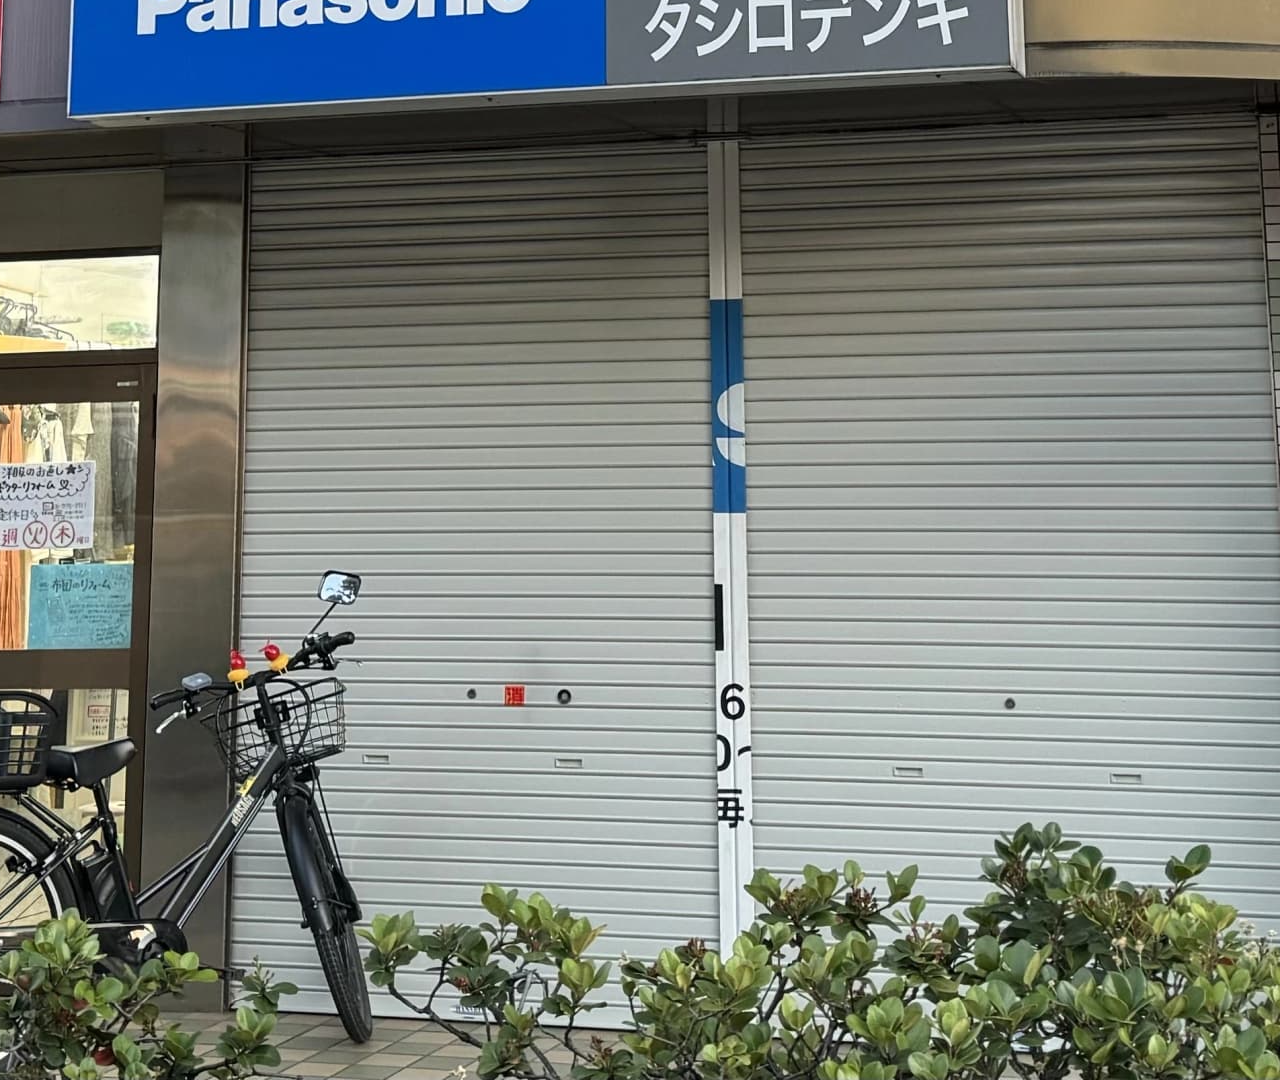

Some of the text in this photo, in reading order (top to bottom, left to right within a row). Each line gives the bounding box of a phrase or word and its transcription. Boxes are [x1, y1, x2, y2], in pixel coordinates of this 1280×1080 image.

[1, 464, 65, 480] 洋服のお直し
[721, 683, 746, 720] 6
